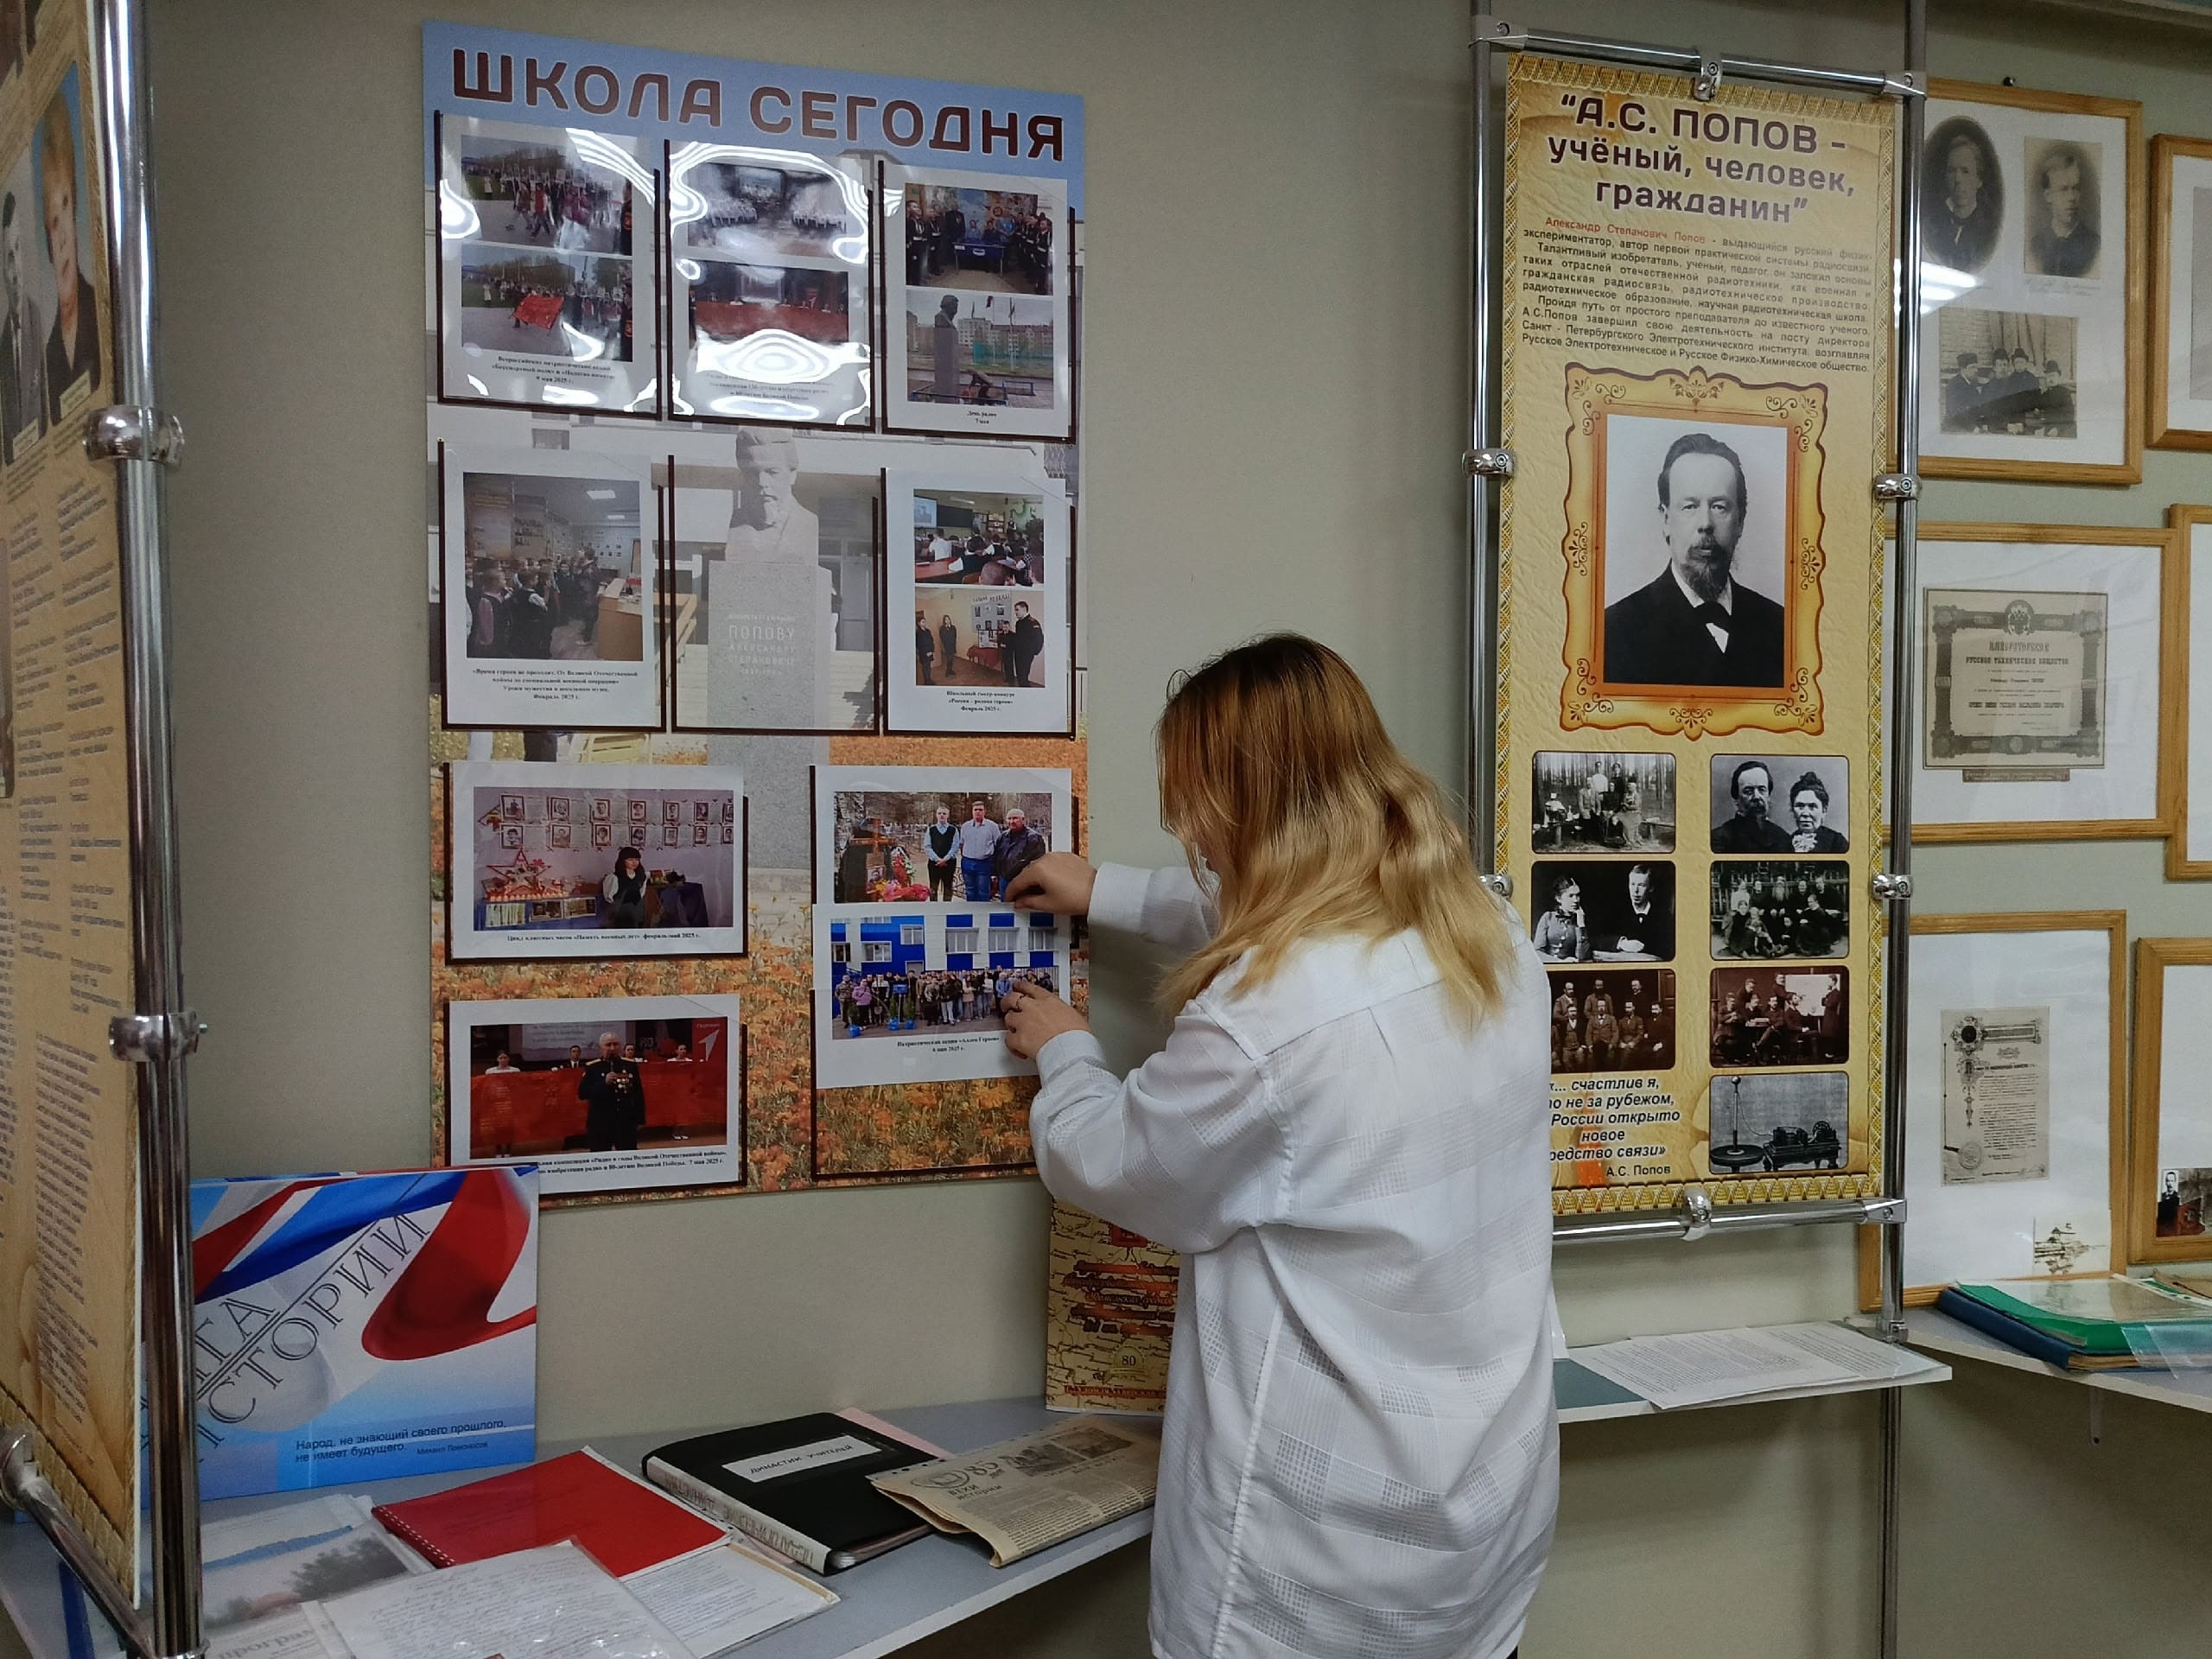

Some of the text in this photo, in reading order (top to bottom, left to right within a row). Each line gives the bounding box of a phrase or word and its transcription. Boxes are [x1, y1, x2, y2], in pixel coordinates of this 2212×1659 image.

[454, 48, 1064, 161] ШКОЛА СЕГОДНЯ
[1673, 108, 1817, 154] ПОПОВ
[1548, 137, 1854, 197] учёный, человек,
[1523, 230, 1615, 247] экспериментатор,
[1620, 240, 1648, 251] автор
[1654, 244, 1688, 254] первой
[1695, 249, 1761, 263] практической
[1766, 257, 1808, 266] системы
[1546, 218, 1600, 232] Александр
[1607, 225, 1667, 238] Степанович
[1675, 232, 1705, 244] Попов
[1723, 238, 1788, 252] выдающийся
[1795, 247, 1832, 258] русский
[1523, 255, 1552, 266] таких
[1562, 261, 1611, 272] отраслей
[1620, 267, 1698, 281] отечественной
[1815, 288, 1857, 297] военная
[1538, 242, 1606, 258] Талантливый
[1611, 251, 1681, 268] изобретатель,
[1790, 271, 1830, 281] заложил
[1835, 276, 1871, 285] основы
[1523, 270, 1594, 283] гражданская
[1683, 287, 1783, 303] радиотехническое
[1523, 283, 1616, 299] радиотехническое
[1699, 301, 1738, 311] научная
[1743, 305, 1831, 320] радиотехническая
[1538, 296, 1576, 308] Пройдя
[1582, 302, 1605, 313] путь
[1626, 306, 1670, 320] простого
[1675, 311, 1749, 326] преподавателя
[1755, 320, 1766, 328] до
[1772, 321, 1825, 332] известного
[1522, 321, 1552, 331] Санкт
[1567, 326, 1643, 340] Петербургского
[1649, 333, 1754, 351] Электротехнического
[1815, 350, 1870, 360] возглавляя
[1586, 315, 1637, 327] завершил
[1646, 321, 1673, 331] свою
[1681, 324, 1753, 339] деятельность
[1781, 334, 1809, 344] посту
[1818, 338, 1870, 349] директора
[1522, 334, 1562, 346] Русское
[1566, 338, 1667, 356] Электротехническое
[1680, 349, 1717, 360] Русское
[1721, 353, 1817, 368] Физико-Химическое
[729, 625, 795, 640] ПОПОВУ
[1572, 1078, 1643, 1090] счастлив
[1648, 1078, 1659, 1090] я,
[1552, 1111, 1680, 1126] России открыто
[1567, 1098, 1582, 1107] не
[1587, 1096, 1602, 1107] за
[1606, 1094, 1674, 1109] рубежом,
[1582, 1130, 1625, 1141] новое
[1618, 1145, 1666, 1158] связи»
[1606, 1166, 1671, 1176] А.С. Попов
[197, 1214, 430, 1449] СТОРИИ
[340, 1436, 353, 1445] не
[357, 1429, 409, 1445] знающий
[411, 1426, 448, 1438] своего
[296, 1452, 309, 1462] не
[313, 1447, 348, 1459] имеет
[750, 1444, 853, 1474] ДИНАСТИИ УЧИТЕЛЕЙ
[948, 1484, 976, 1496] ВЕХИ
